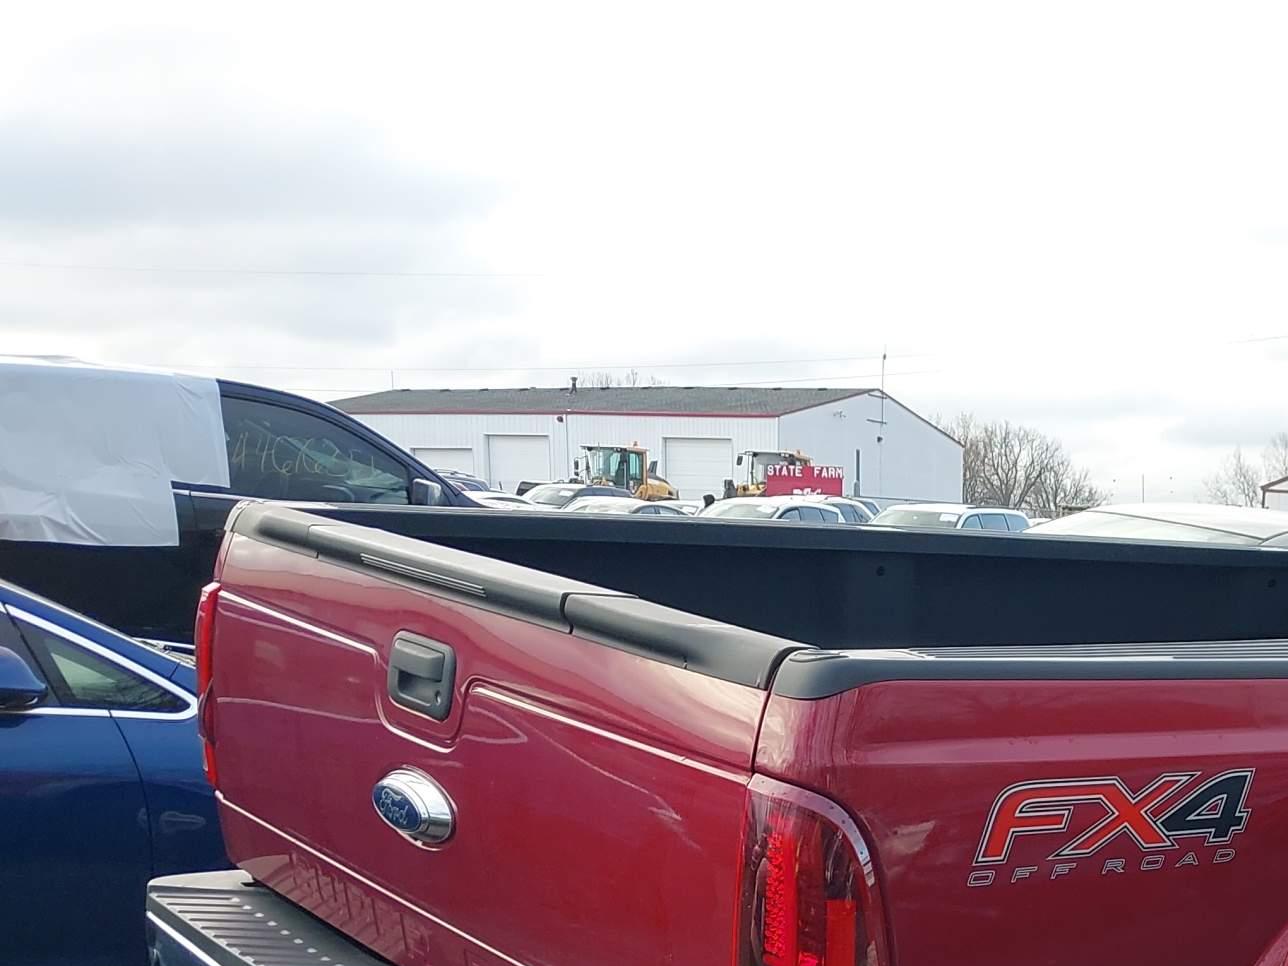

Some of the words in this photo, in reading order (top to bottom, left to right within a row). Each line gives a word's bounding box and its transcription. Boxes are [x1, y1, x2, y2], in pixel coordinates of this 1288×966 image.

[767, 464, 803, 477] STATE
[813, 467, 844, 479] FARM
[972, 768, 1256, 866] FX4
[966, 863, 1077, 887] OFF
[1101, 848, 1236, 875] ROAD
